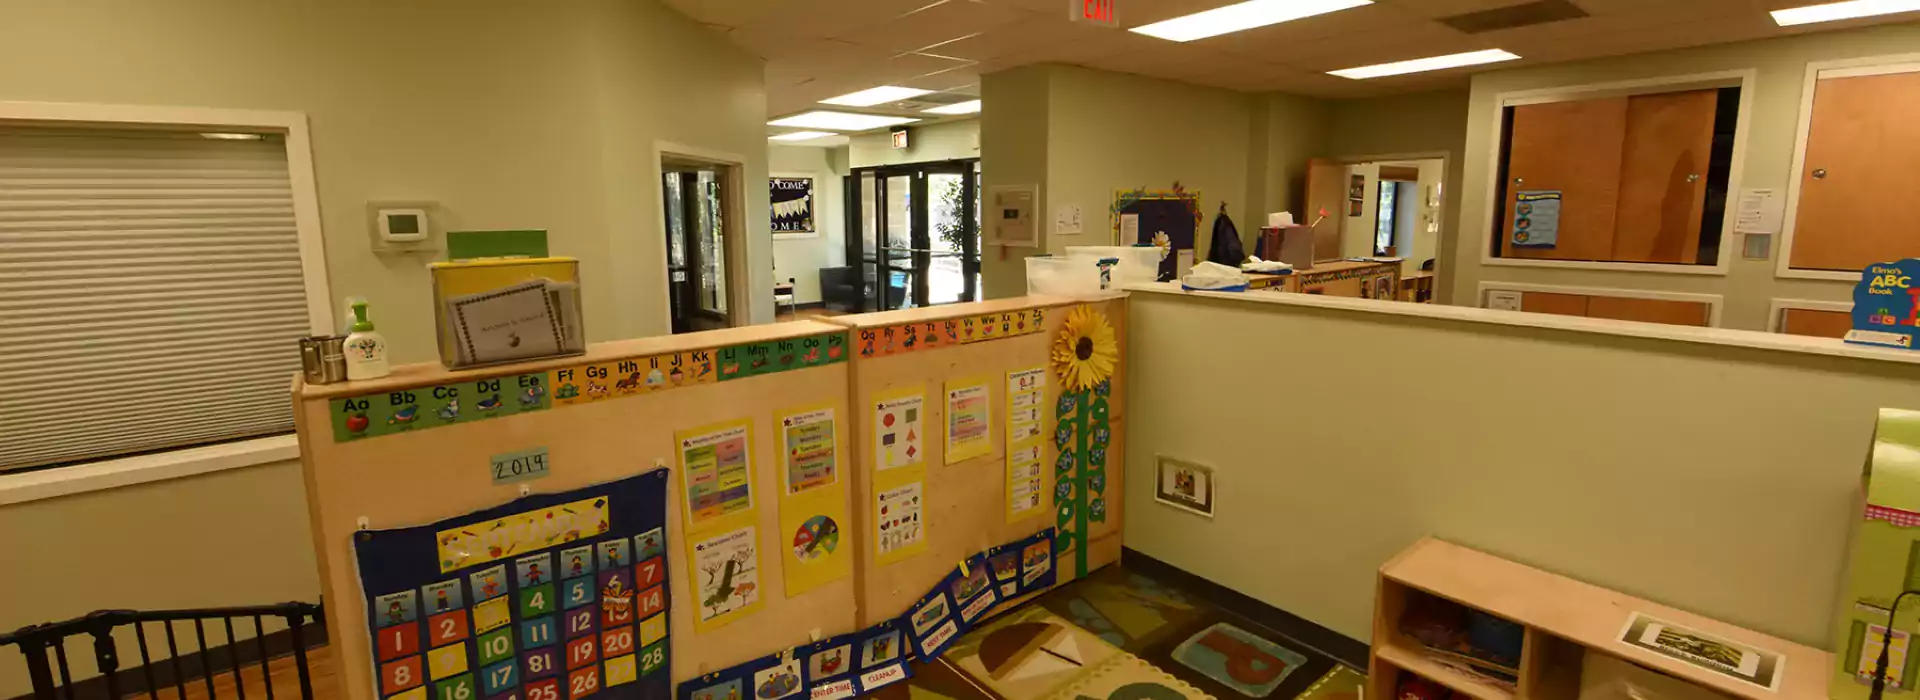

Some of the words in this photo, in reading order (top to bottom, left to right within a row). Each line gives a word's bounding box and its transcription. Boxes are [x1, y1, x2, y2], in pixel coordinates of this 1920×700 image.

[1868, 287, 1893, 295] Book
[1870, 274, 1912, 289] ABC
[747, 345, 769, 356] Mm
[778, 341, 794, 352] Nn
[803, 338, 819, 348] Oo
[558, 369, 574, 382] Ff
[586, 366, 608, 379] Gg
[618, 361, 638, 374] Hh
[671, 353, 683, 367] Jj
[691, 351, 709, 363] Kk
[343, 398, 370, 413] Aa
[390, 391, 416, 406] Bb
[432, 385, 458, 400] Cc
[477, 379, 500, 394] Dd
[518, 375, 539, 388] Ee
[496, 454, 544, 479] 2019
[395, 631, 402, 652] 1
[440, 618, 457, 640] 2
[529, 591, 545, 610] 4
[571, 582, 585, 601] 5
[644, 563, 656, 583] 7
[394, 665, 411, 686] 8
[440, 652, 457, 671] 9
[485, 636, 509, 659] 10
[531, 623, 548, 643] 11
[572, 612, 591, 633] 12
[643, 592, 660, 612] 14
[445, 681, 470, 700] 16
[491, 665, 512, 689] 17
[574, 641, 593, 663] 19
[605, 632, 632, 653] 20
[529, 684, 558, 700] 25
[572, 671, 597, 695] 26
[609, 659, 632, 682] 27
[642, 647, 664, 671] 28
